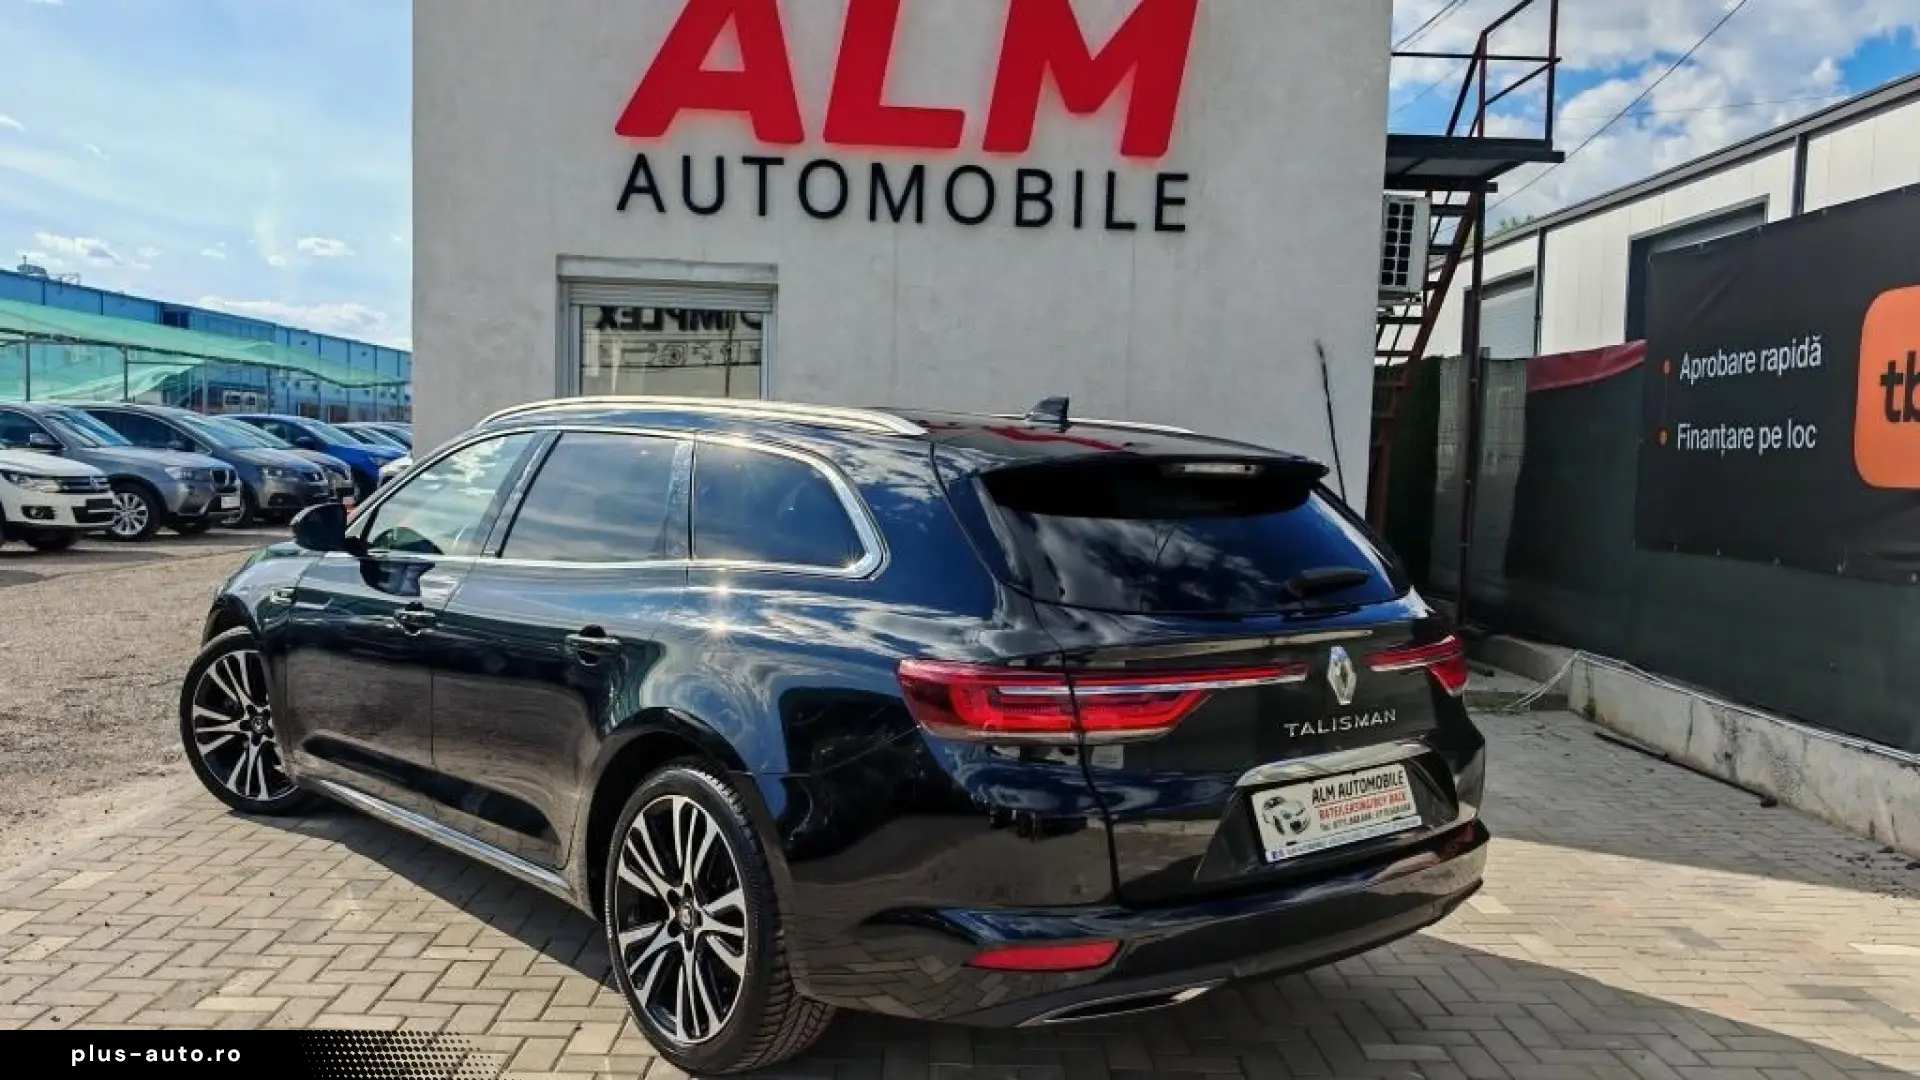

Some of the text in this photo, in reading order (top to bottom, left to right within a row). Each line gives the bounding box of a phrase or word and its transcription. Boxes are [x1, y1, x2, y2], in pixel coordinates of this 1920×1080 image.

[614, 0, 1199, 158] ALM
[616, 152, 1190, 232] AUTOMOBILE
[1680, 334, 1823, 384] Aprobare rapidă
[1677, 418, 1817, 458] Finanțare pe loc
[1284, 708, 1397, 738] TALISMAN
[1312, 770, 1404, 804] ALM AUTOMOBILE
